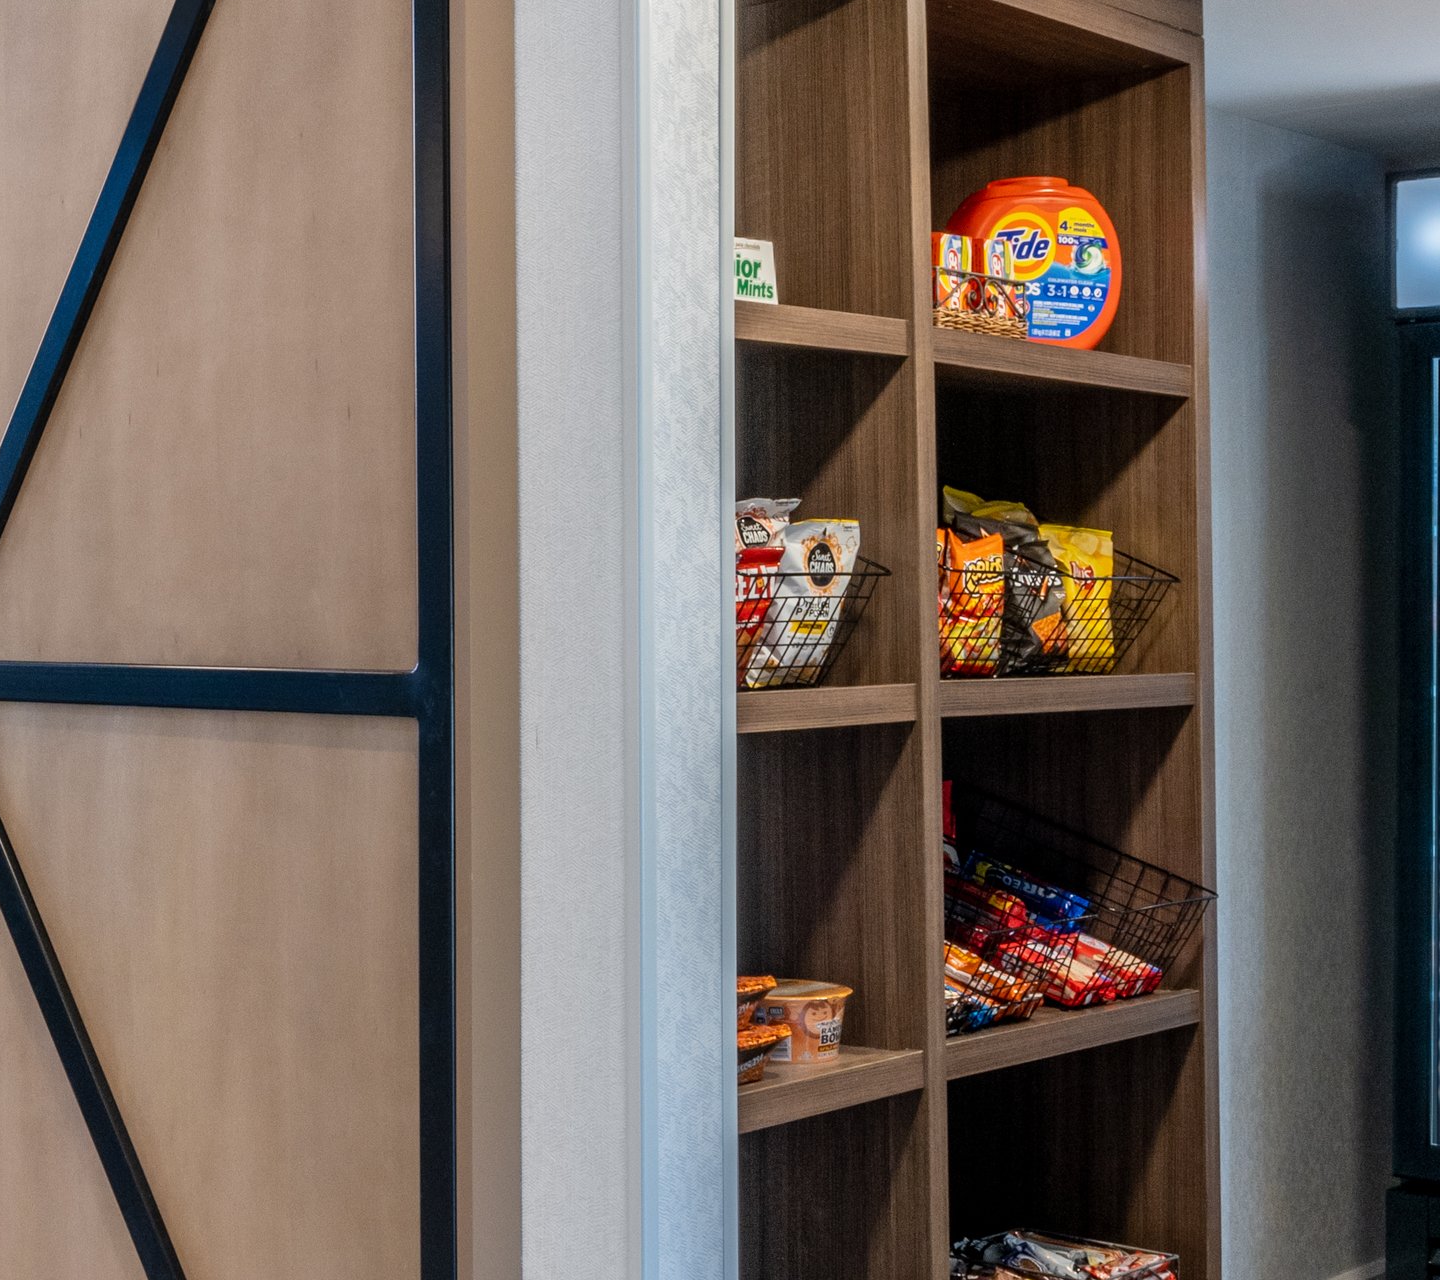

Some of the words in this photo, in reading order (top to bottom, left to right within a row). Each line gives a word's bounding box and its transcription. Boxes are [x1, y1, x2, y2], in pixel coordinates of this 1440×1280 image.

[994, 228, 1050, 261] Tide
[735, 253, 762, 279] ior
[737, 278, 774, 299] Mints
